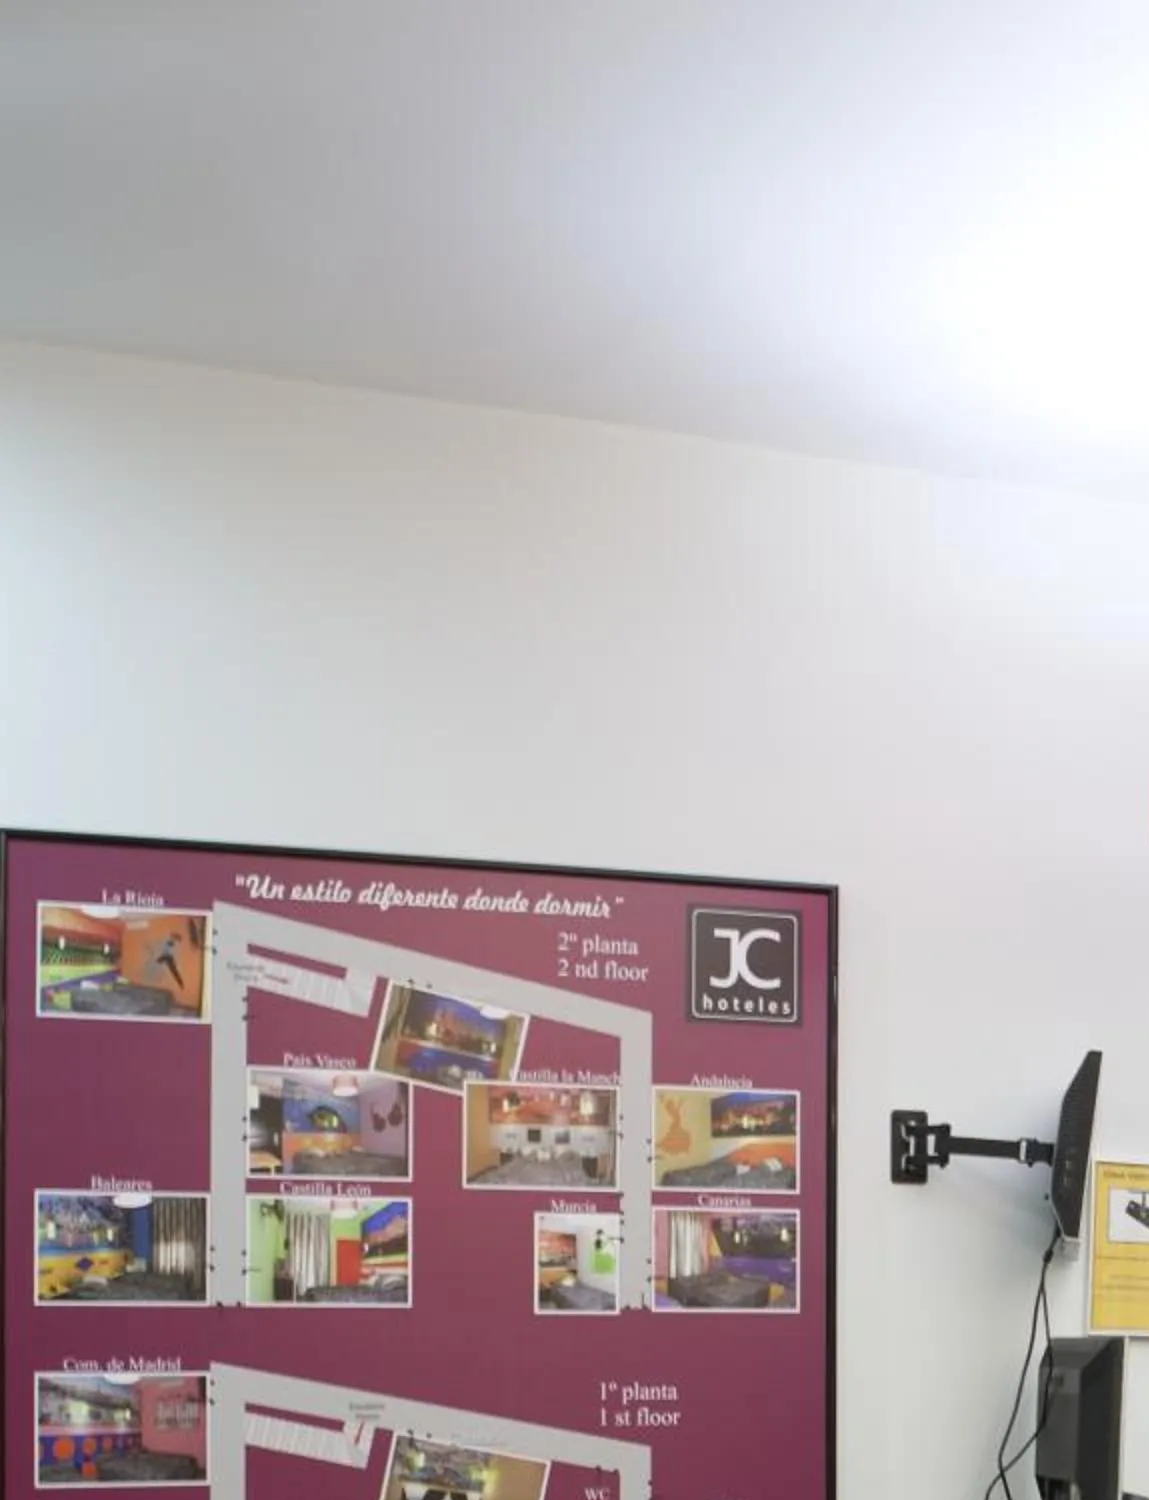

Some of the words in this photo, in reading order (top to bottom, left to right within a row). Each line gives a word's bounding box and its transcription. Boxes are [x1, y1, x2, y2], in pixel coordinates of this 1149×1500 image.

[102, 888, 121, 905] La
[290, 880, 352, 904] estilo
[358, 881, 458, 912] diferente
[463, 887, 529, 913] donde
[582, 933, 639, 957] planta
[709, 927, 781, 990] JC
[558, 957, 569, 977] 2
[575, 959, 598, 979] nd
[604, 960, 649, 982] floor
[702, 993, 791, 1015] hoteles
[90, 1174, 153, 1191] Baleares
[279, 1180, 332, 1196] Castilla
[550, 1198, 597, 1214] Murcia
[697, 1193, 752, 1208] Canarias
[108, 1356, 124, 1373] de
[129, 1356, 182, 1373] Madrid
[622, 1381, 677, 1405] planta
[615, 1409, 631, 1427] st
[637, 1406, 681, 1427] floor
